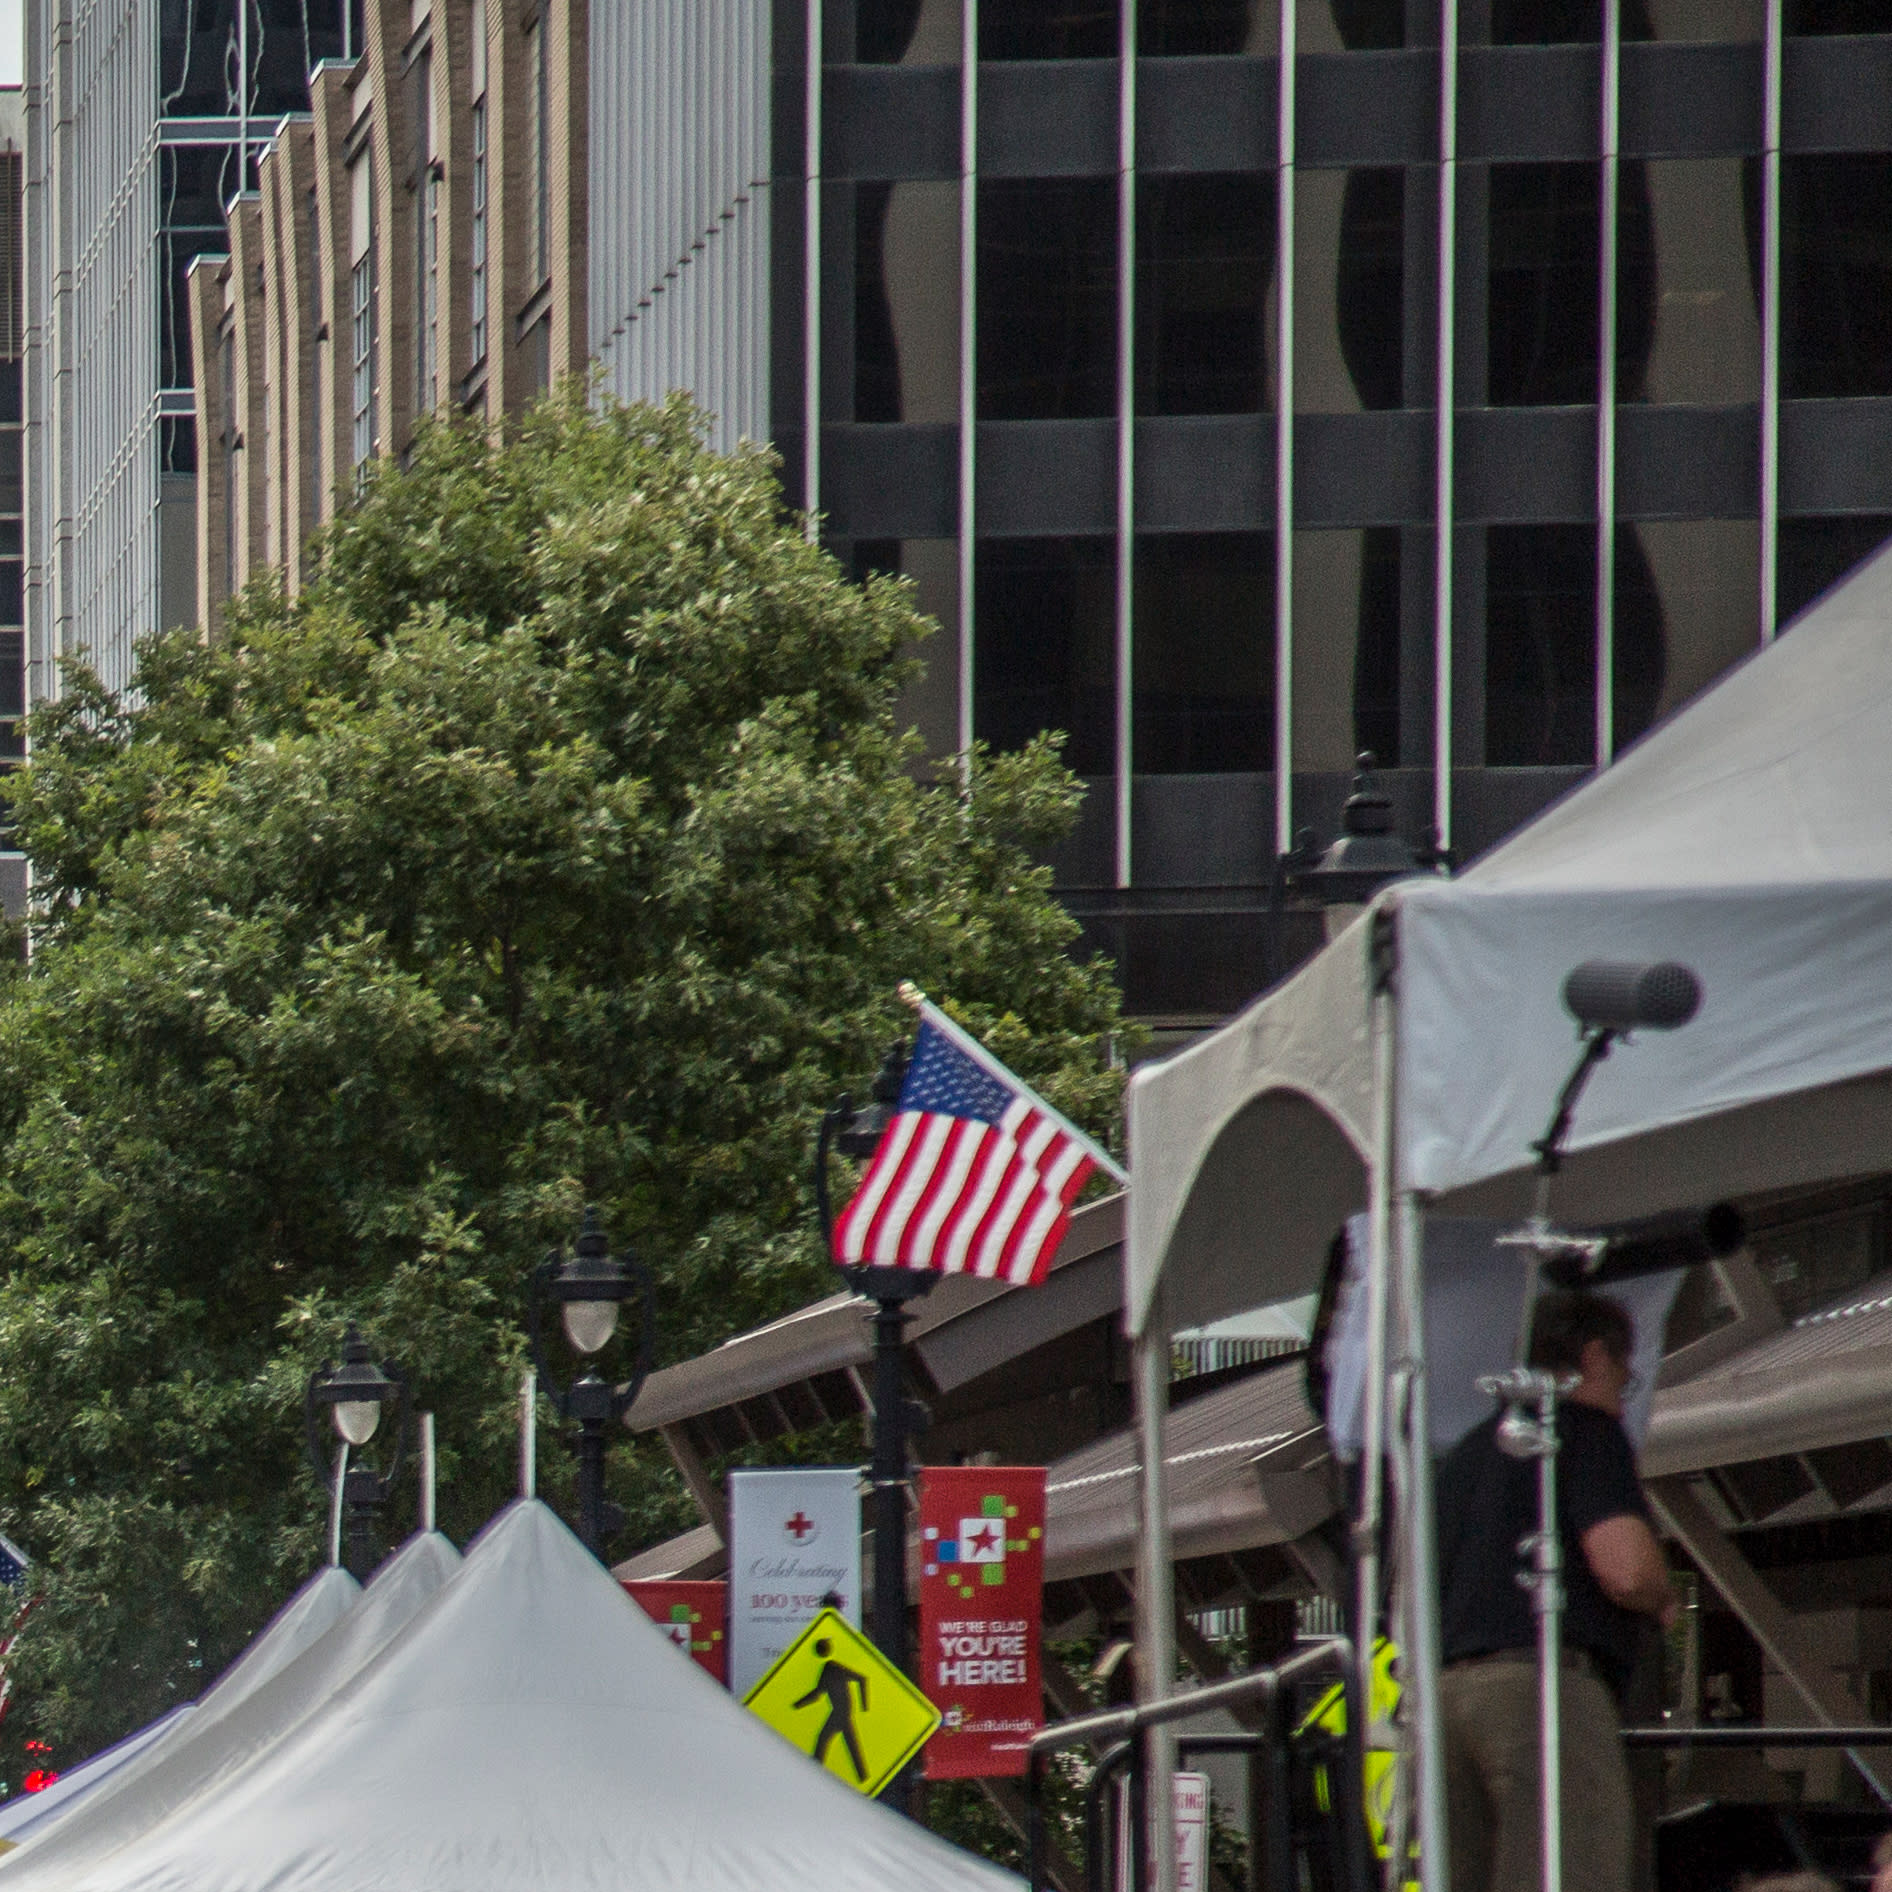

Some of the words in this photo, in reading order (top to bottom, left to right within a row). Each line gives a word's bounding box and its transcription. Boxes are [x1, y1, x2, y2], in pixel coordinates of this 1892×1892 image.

[751, 1593, 788, 1609] 100
[791, 1593, 849, 1613] yes
[938, 1620, 987, 1634] WE'RE
[989, 1619, 1028, 1633] GLAD
[938, 1635, 1028, 1657] YOU'RE
[938, 1659, 1028, 1686] HERE!
